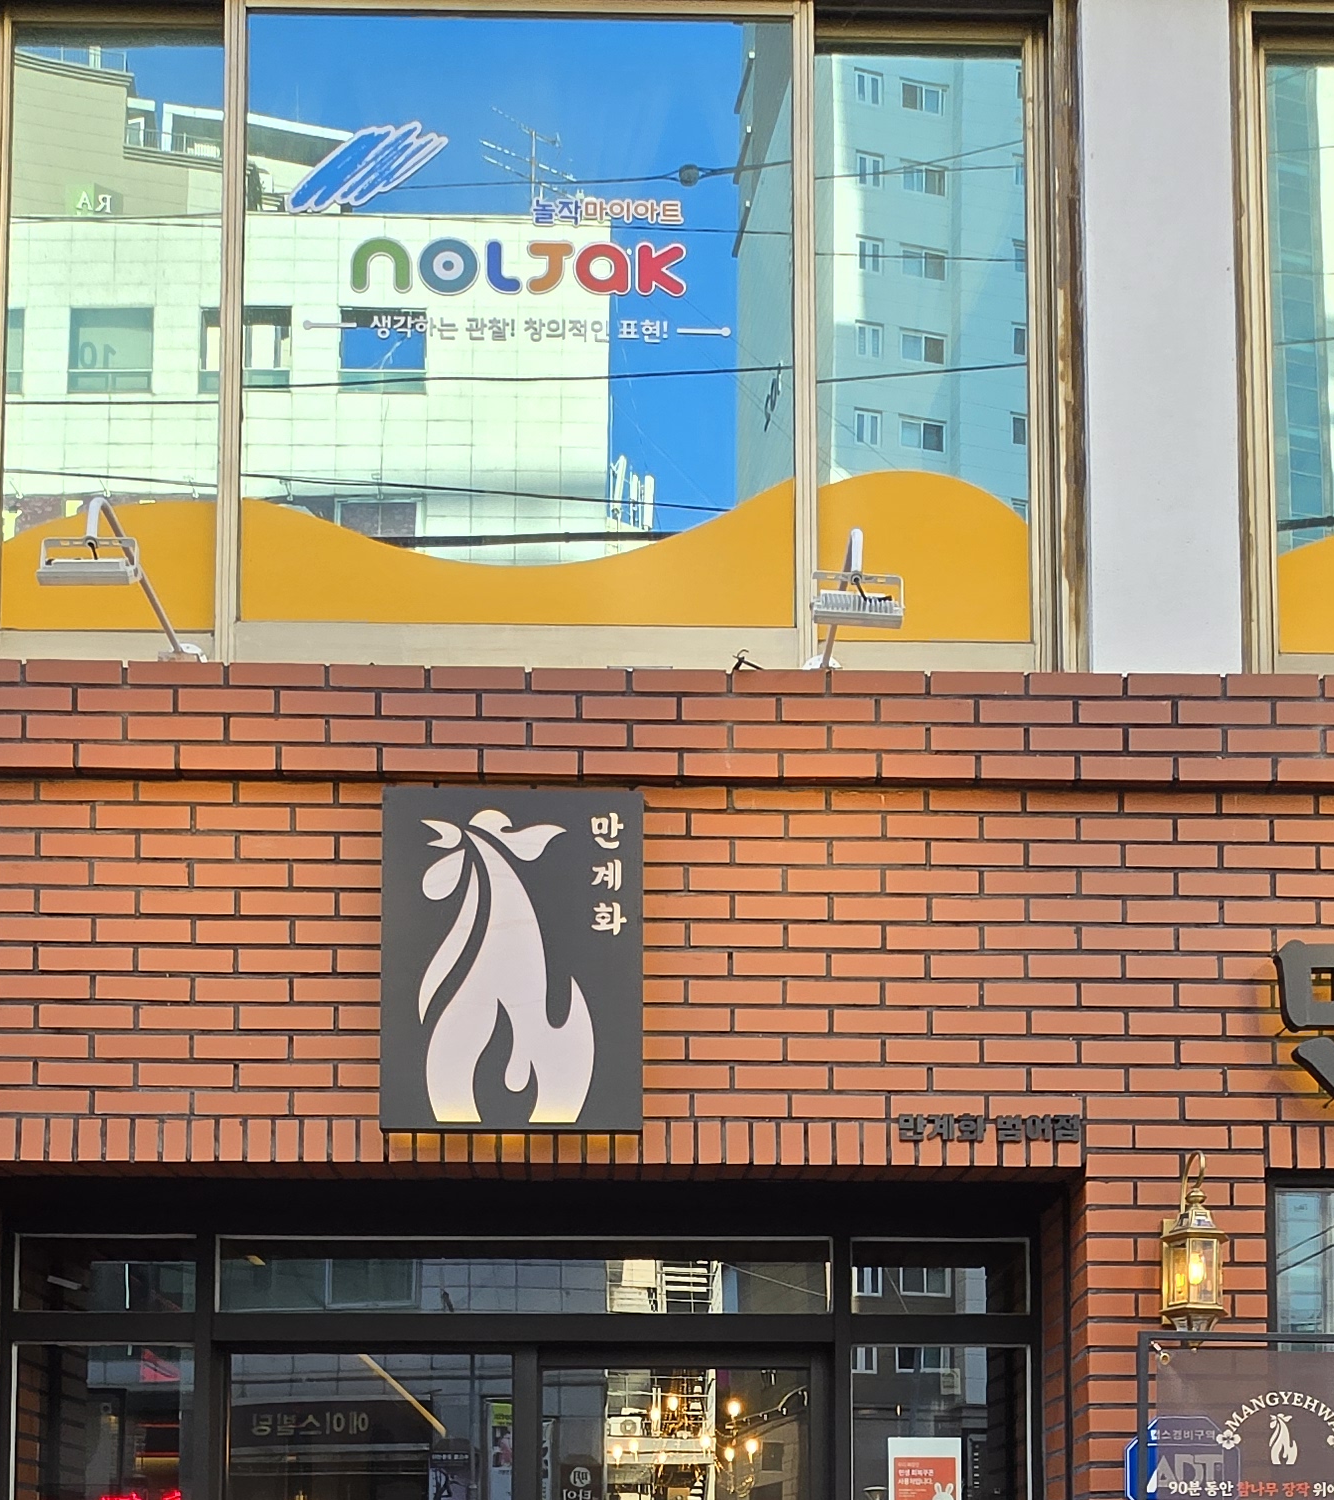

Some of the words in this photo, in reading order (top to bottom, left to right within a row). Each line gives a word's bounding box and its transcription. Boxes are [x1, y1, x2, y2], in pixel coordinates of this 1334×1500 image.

[532, 199, 684, 227] 놀작마이아트
[370, 315, 459, 341] 생각하는
[465, 316, 516, 342] 관찰!
[524, 317, 610, 343] 창의적인
[618, 319, 669, 344] 표현!
[590, 812, 627, 936] 만계화
[898, 1113, 986, 1142] 만계화
[996, 1114, 1082, 1143] 범어점
[1147, 1453, 1224, 1493] ADT
[1168, 1481, 1202, 1497] 90분
[1204, 1481, 1234, 1498] 동안
[1236, 1481, 1279, 1498] 참나무
[1281, 1481, 1310, 1498] 장작
